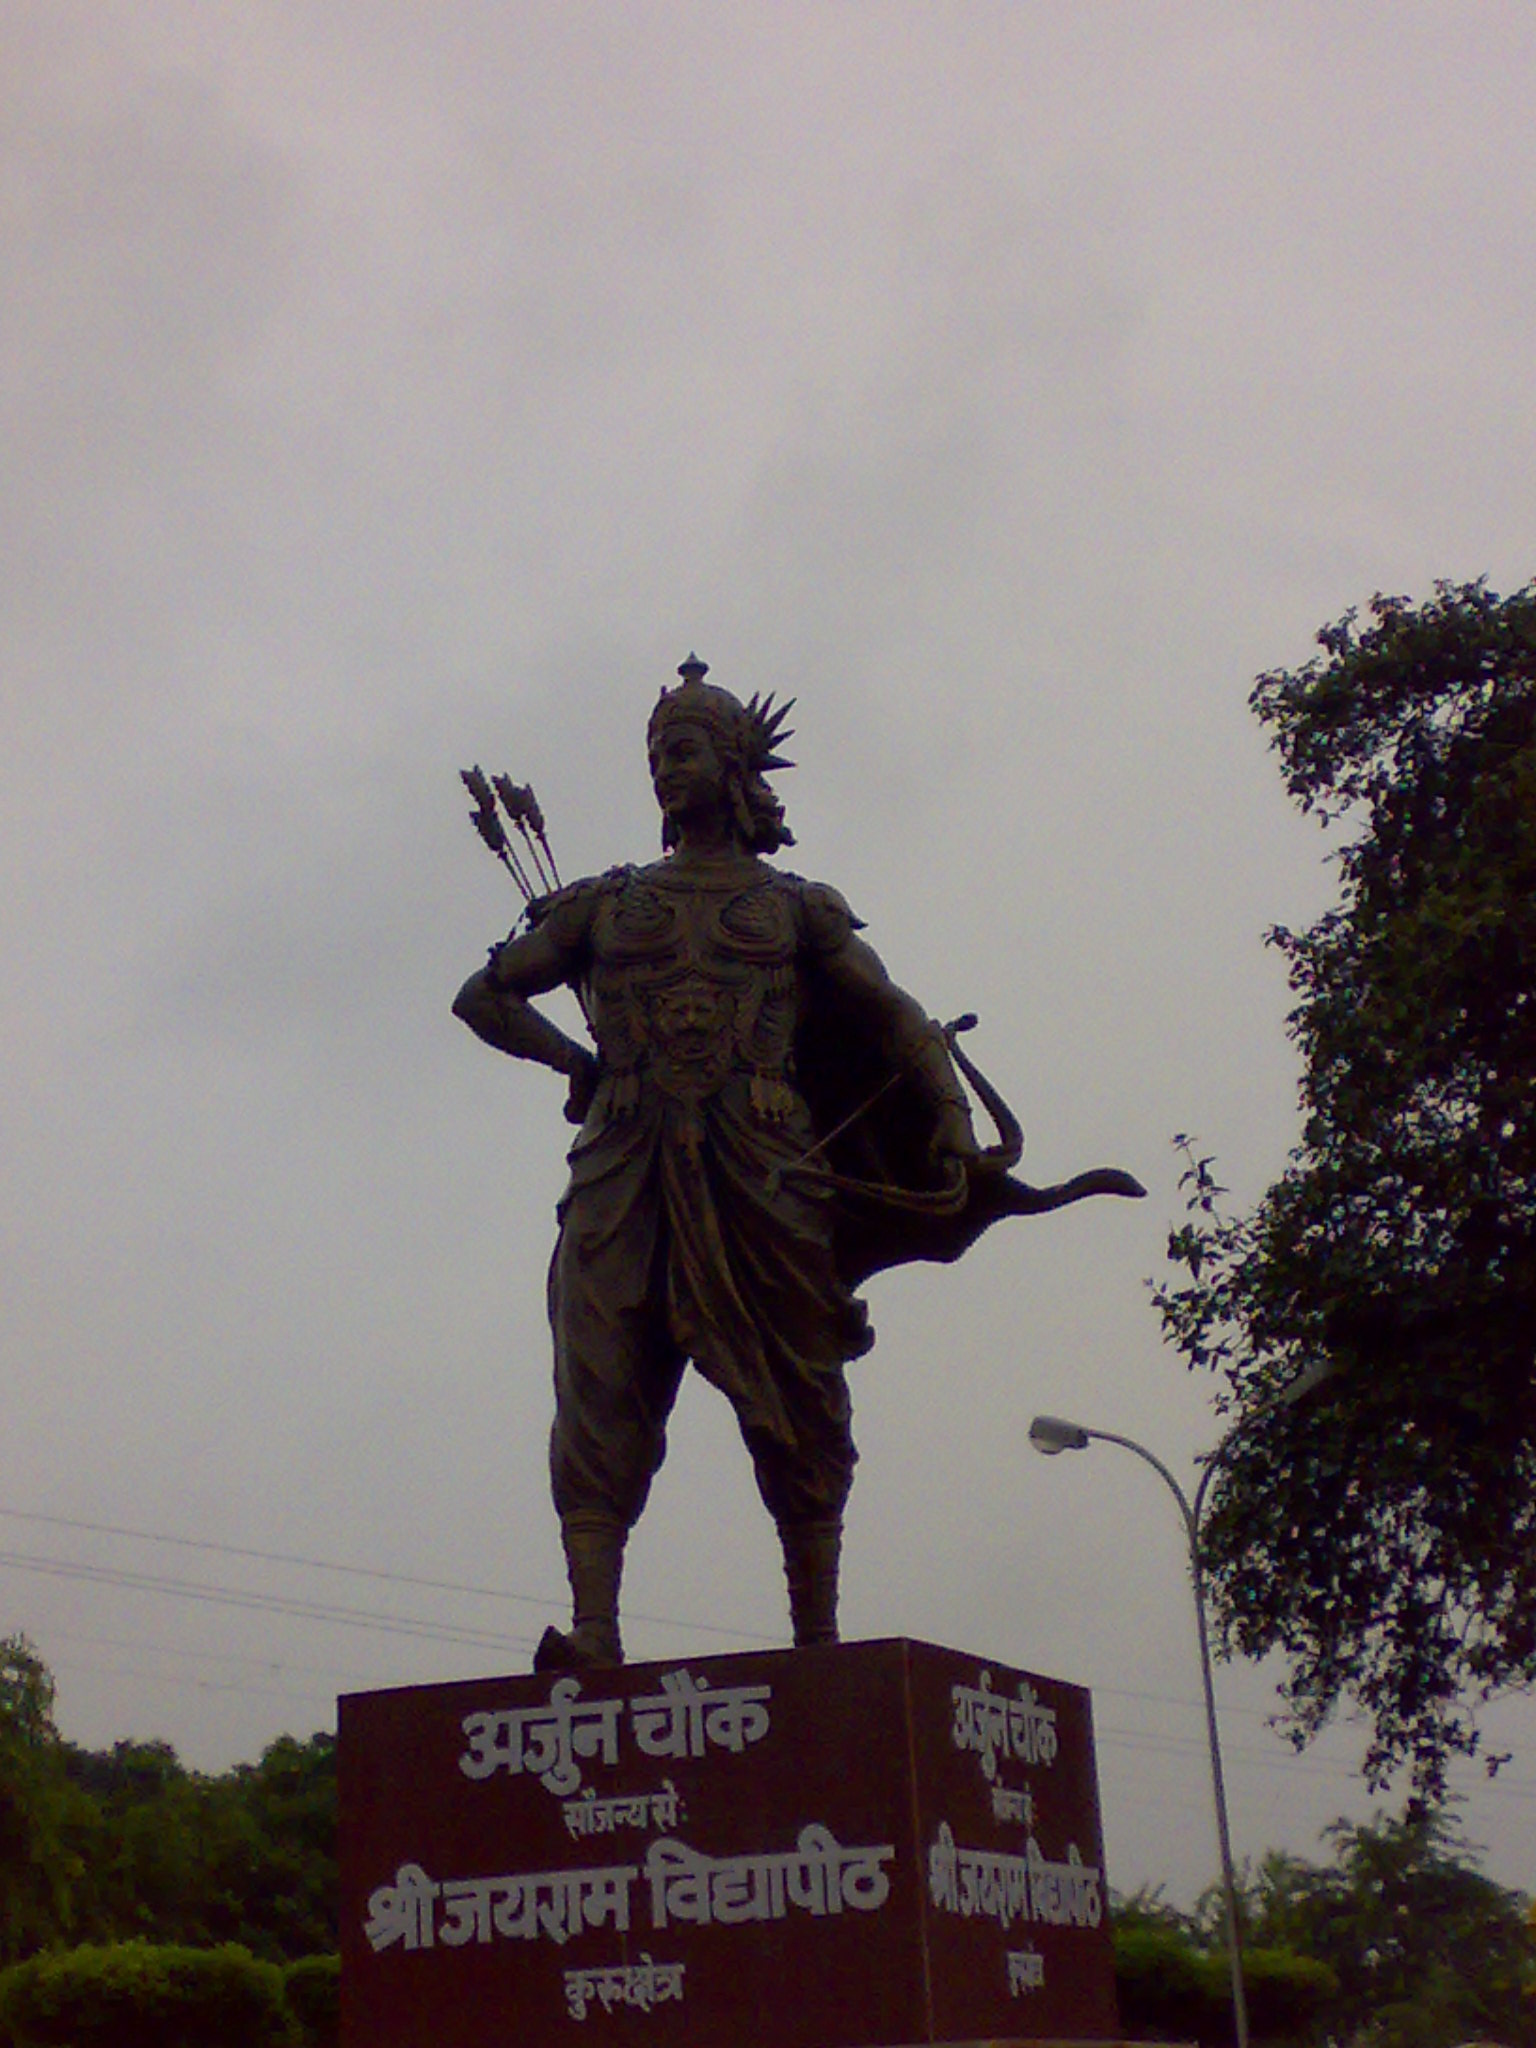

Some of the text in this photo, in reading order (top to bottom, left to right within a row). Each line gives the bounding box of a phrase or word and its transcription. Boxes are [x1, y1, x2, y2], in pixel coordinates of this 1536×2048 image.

[459, 1668, 772, 1796] अर्जुन चौंक
[952, 1670, 1010, 1780] अर्जुन
[363, 1822, 895, 1953] श्री जयराम विद्यापीठ
